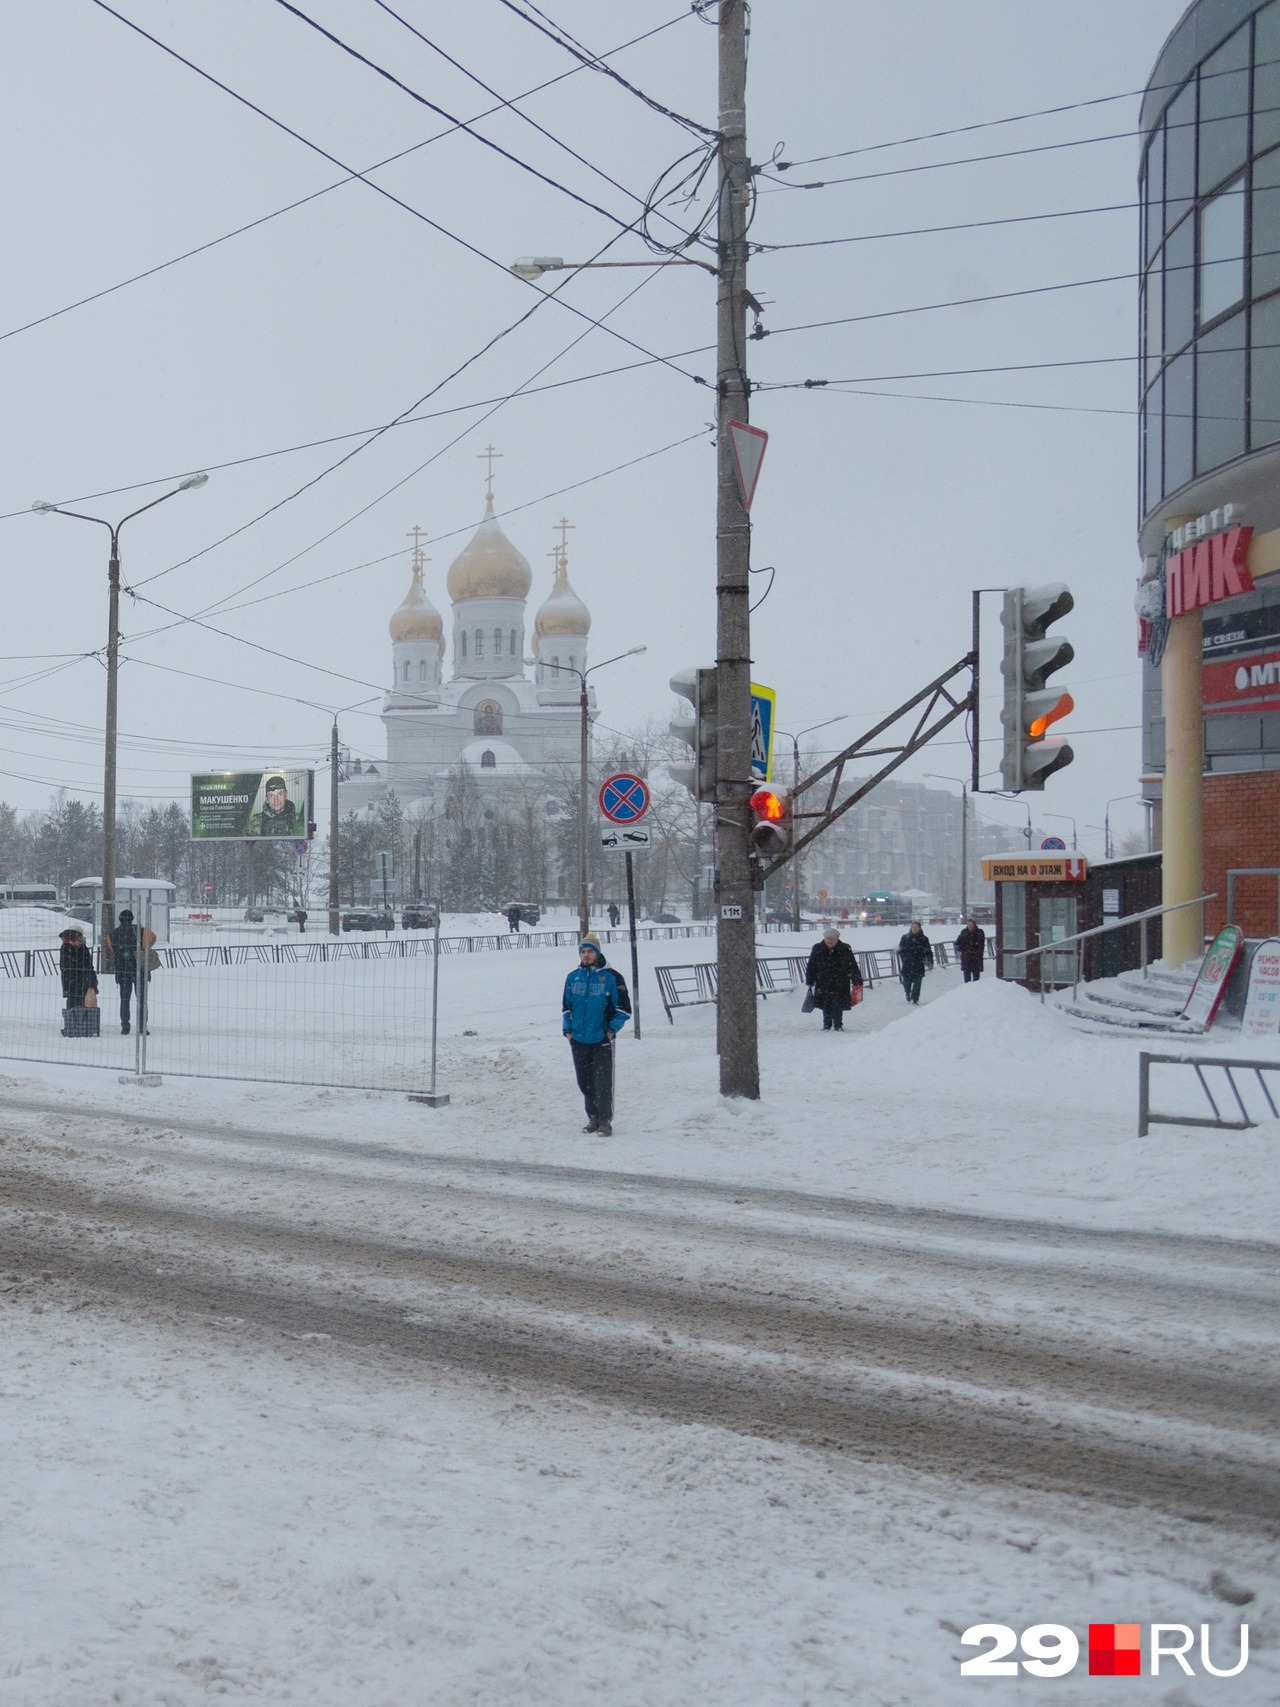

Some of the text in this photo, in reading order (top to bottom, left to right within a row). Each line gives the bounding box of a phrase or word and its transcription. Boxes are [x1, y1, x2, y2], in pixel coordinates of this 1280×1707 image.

[1173, 503, 1236, 549] ЦЕНТР
[1167, 526, 1251, 619] ПИК
[1214, 631, 1245, 644] СВЯЗИ
[200, 794, 249, 804] МАКУШЕНКО
[993, 865, 1062, 876] ВХОД НА 0 ЭТАЖ
